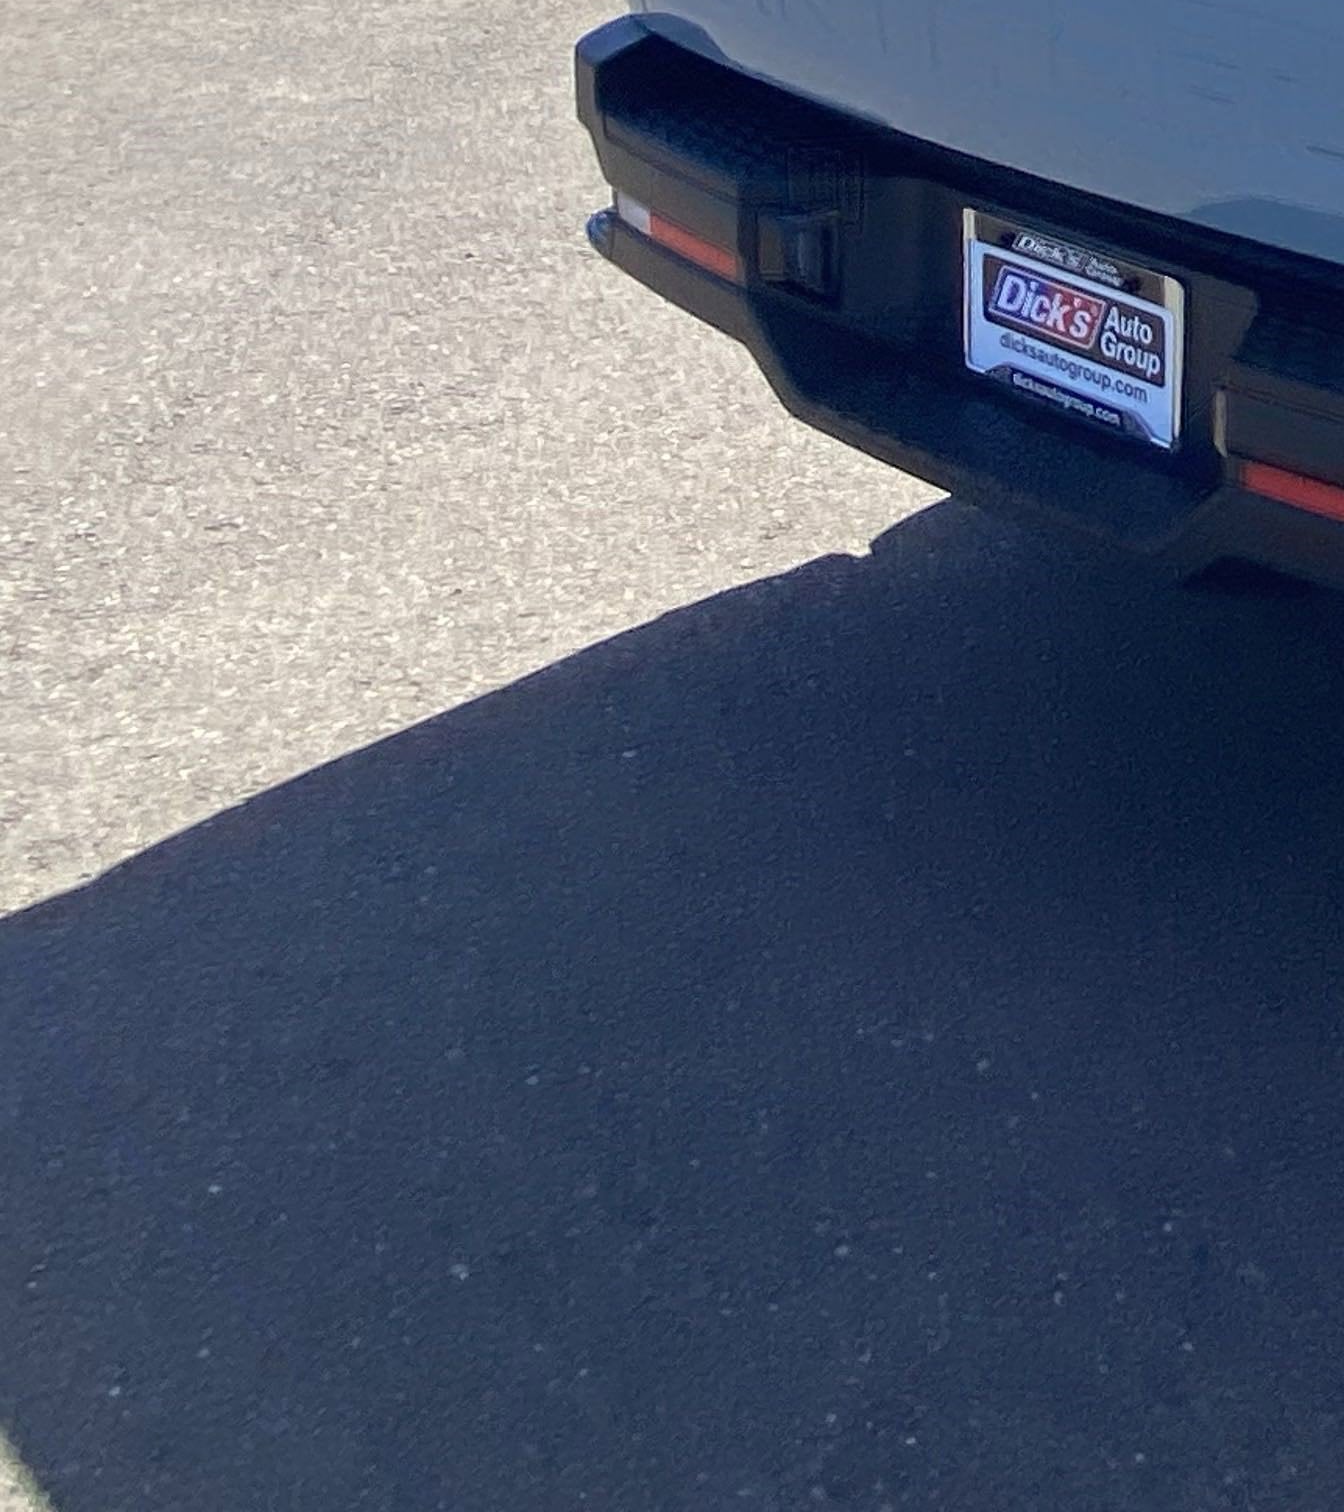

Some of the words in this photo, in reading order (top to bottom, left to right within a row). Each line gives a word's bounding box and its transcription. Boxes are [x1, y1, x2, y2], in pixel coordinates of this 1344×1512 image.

[997, 272, 1094, 340] Dick's
[1104, 306, 1153, 344] Auto
[1000, 332, 1149, 404] dicksautogroup.com
[1100, 333, 1160, 377] Group
